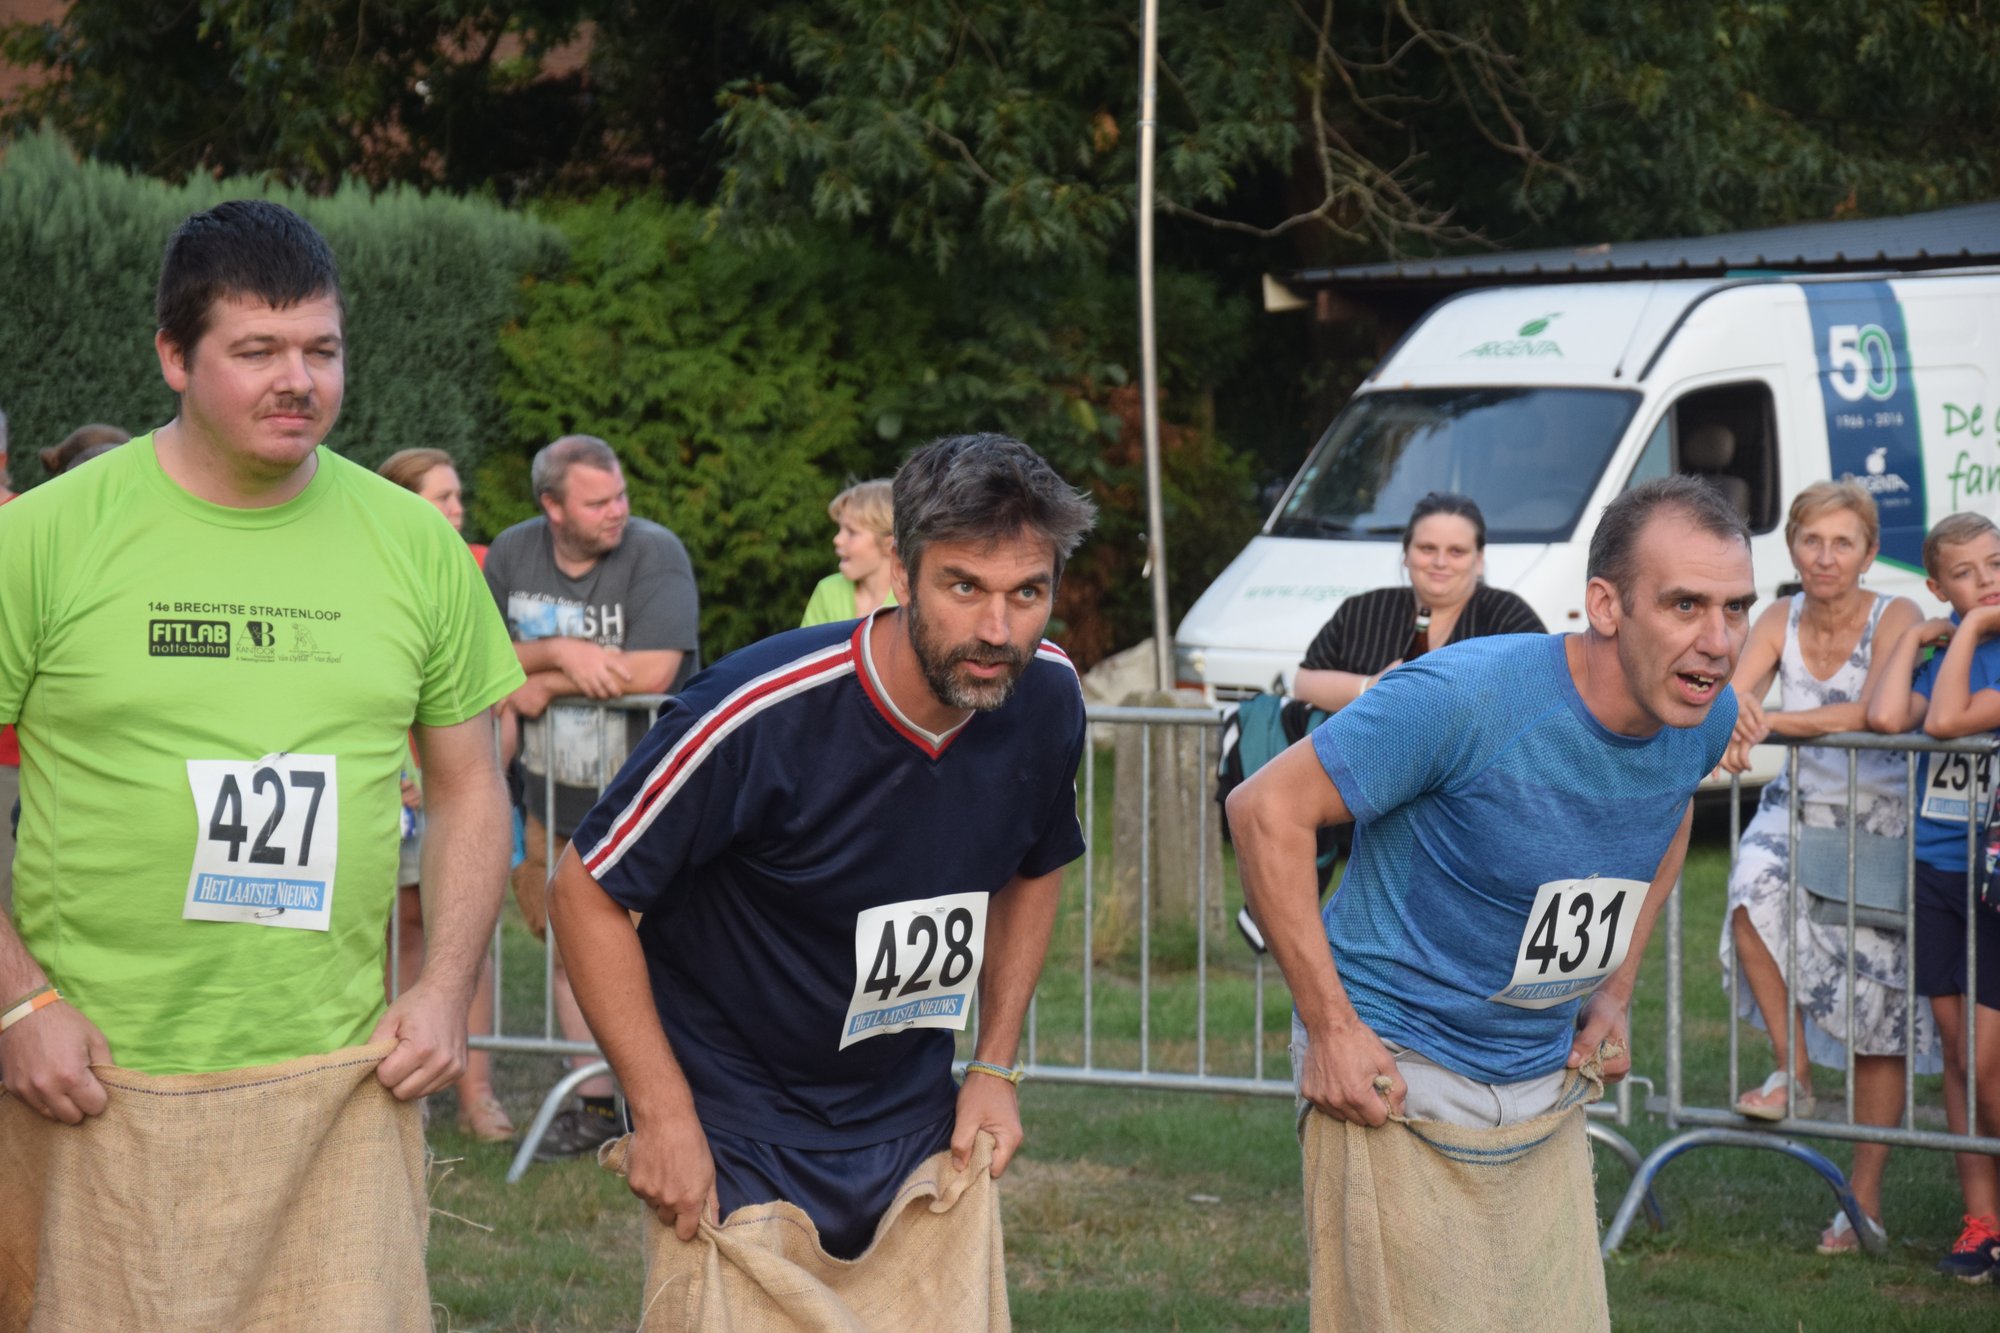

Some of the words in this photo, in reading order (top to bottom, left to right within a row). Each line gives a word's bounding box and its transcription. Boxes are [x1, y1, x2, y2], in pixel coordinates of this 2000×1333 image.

[1457, 340, 1565, 357] ARGENTA
[1829, 324, 1897, 401] 50
[1942, 402, 1984, 437] De
[149, 602, 170, 612] 14e
[174, 602, 246, 615] BRECHTSE
[250, 605, 341, 621] STRATENLOOP
[152, 623, 229, 643] FITLAB
[152, 643, 227, 655] nottebohm
[1932, 752, 1991, 793] 254
[208, 766, 326, 866] 427
[200, 876, 227, 901] HET
[225, 878, 276, 906] LAATSTE
[274, 881, 319, 908] NIEUWS
[1525, 890, 1627, 975] 431
[863, 907, 973, 1001] 428
[1529, 980, 1569, 999] LAATSTE
[852, 1013, 875, 1033] HET
[873, 1003, 919, 1026] LAATSTE
[917, 998, 959, 1016] NIEUWS
